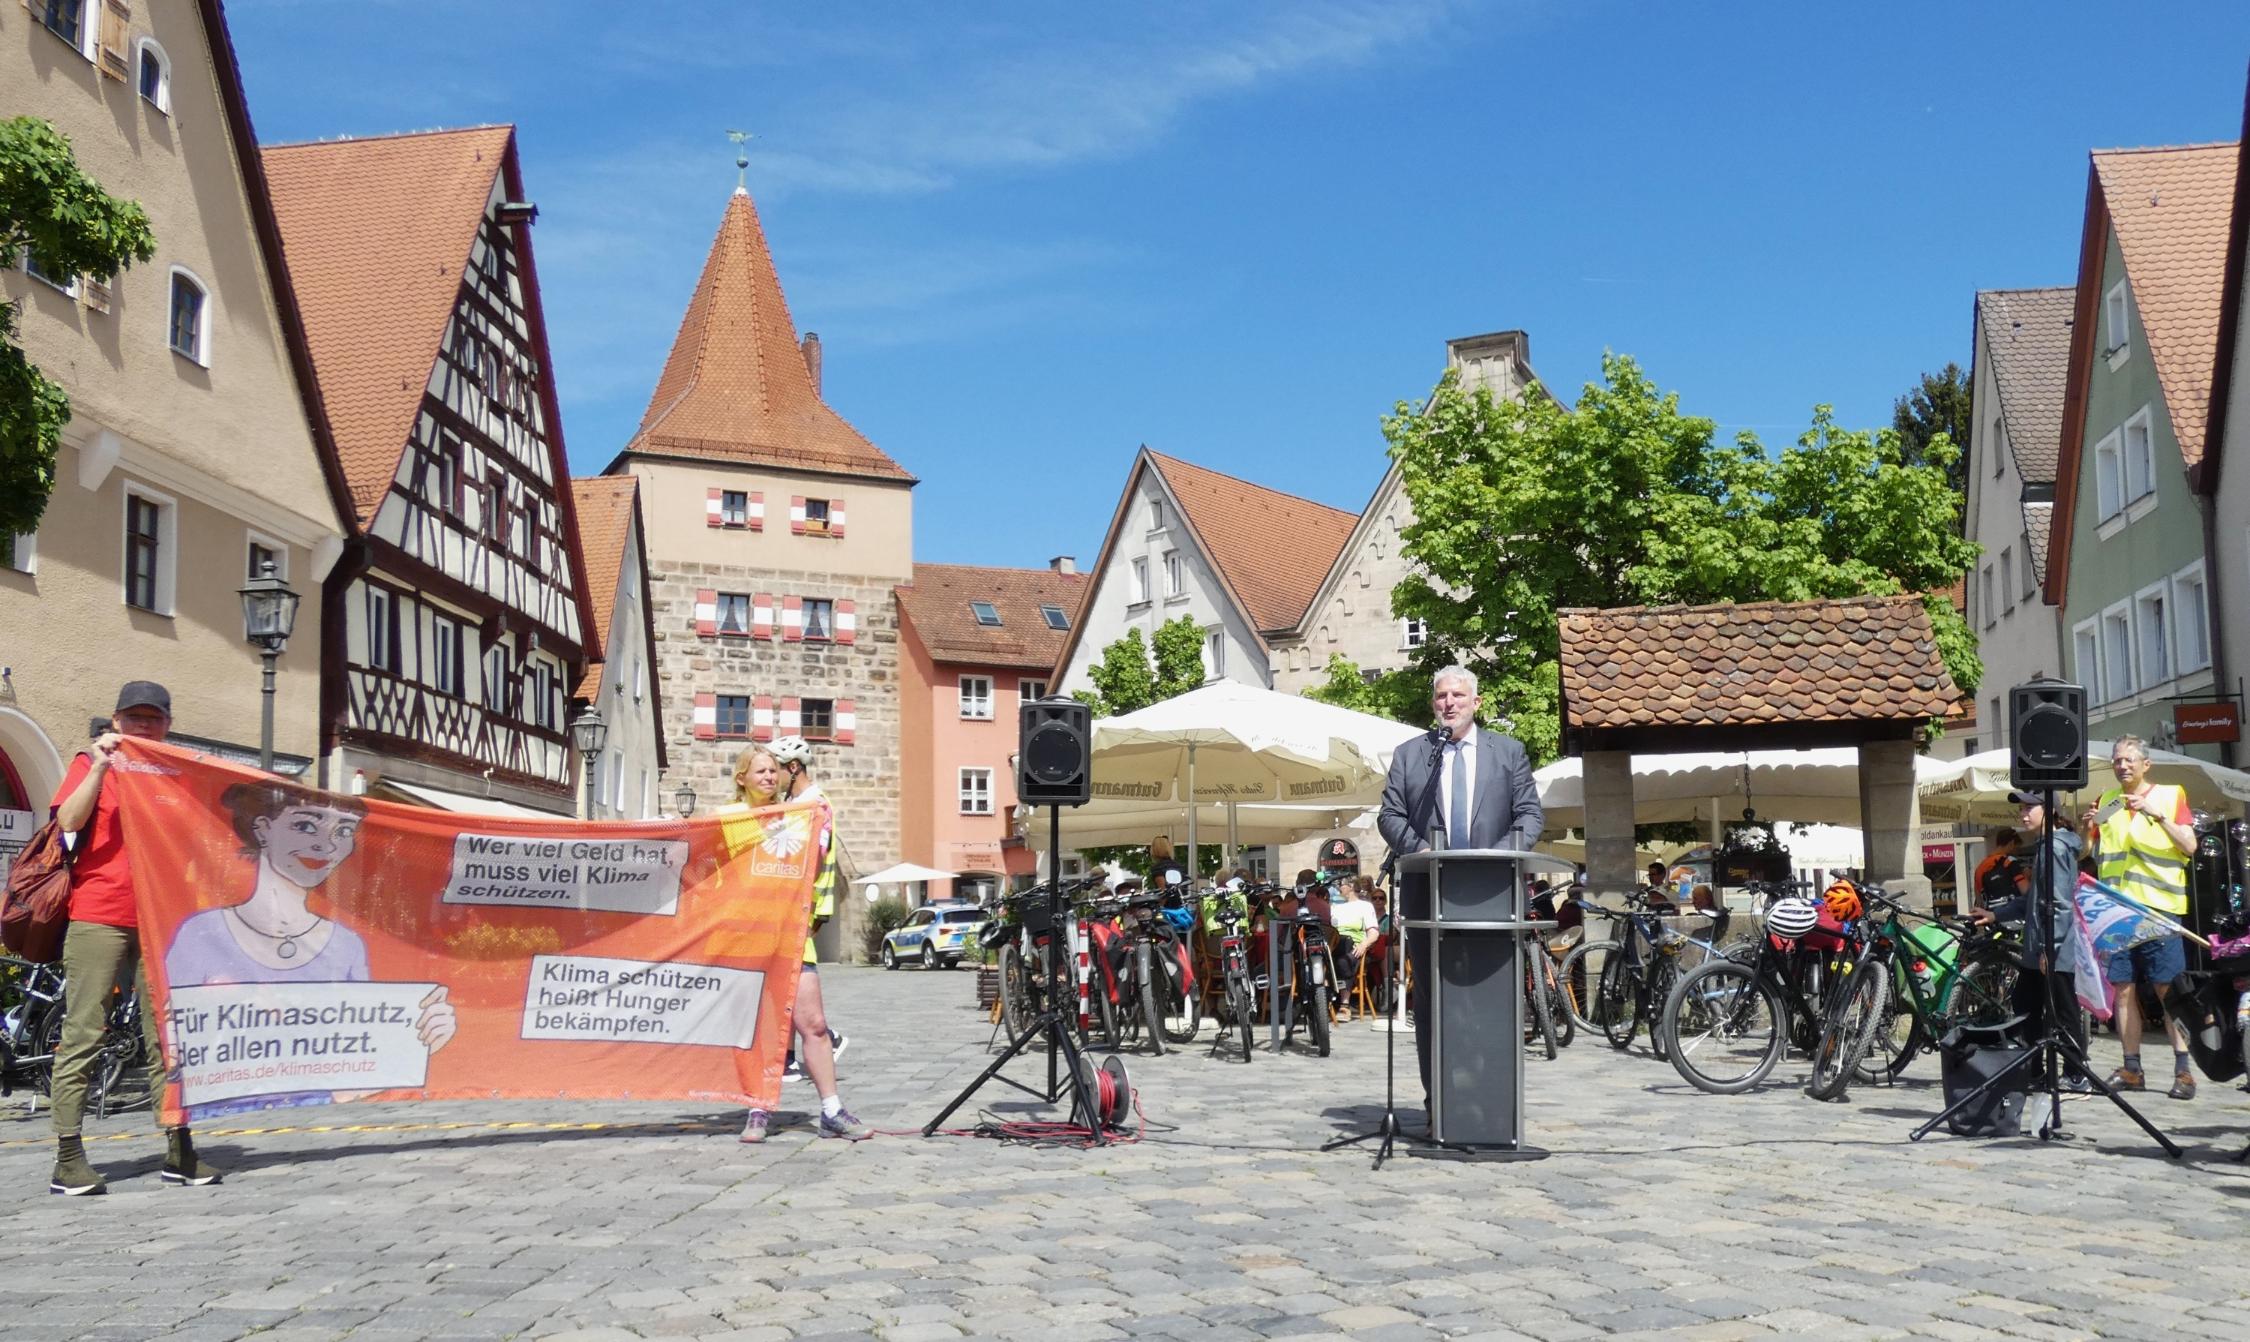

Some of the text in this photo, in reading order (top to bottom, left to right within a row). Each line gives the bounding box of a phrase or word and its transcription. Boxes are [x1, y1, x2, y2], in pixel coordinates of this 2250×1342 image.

[2208, 717, 2232, 727] family
[1921, 829, 1953, 841] oldankau
[468, 836, 674, 868] Wer viel Geld hat,
[465, 862, 651, 884] muss viel Klima
[755, 860, 800, 876] caritas
[457, 884, 571, 900] schützen.
[543, 963, 722, 992] Klima schützen
[538, 987, 691, 1015] heißt Hunger
[173, 1000, 413, 1034] Für Klimaschutz,
[534, 1011, 671, 1036] bekämpfen.
[178, 1031, 378, 1068] der allen nutzt.
